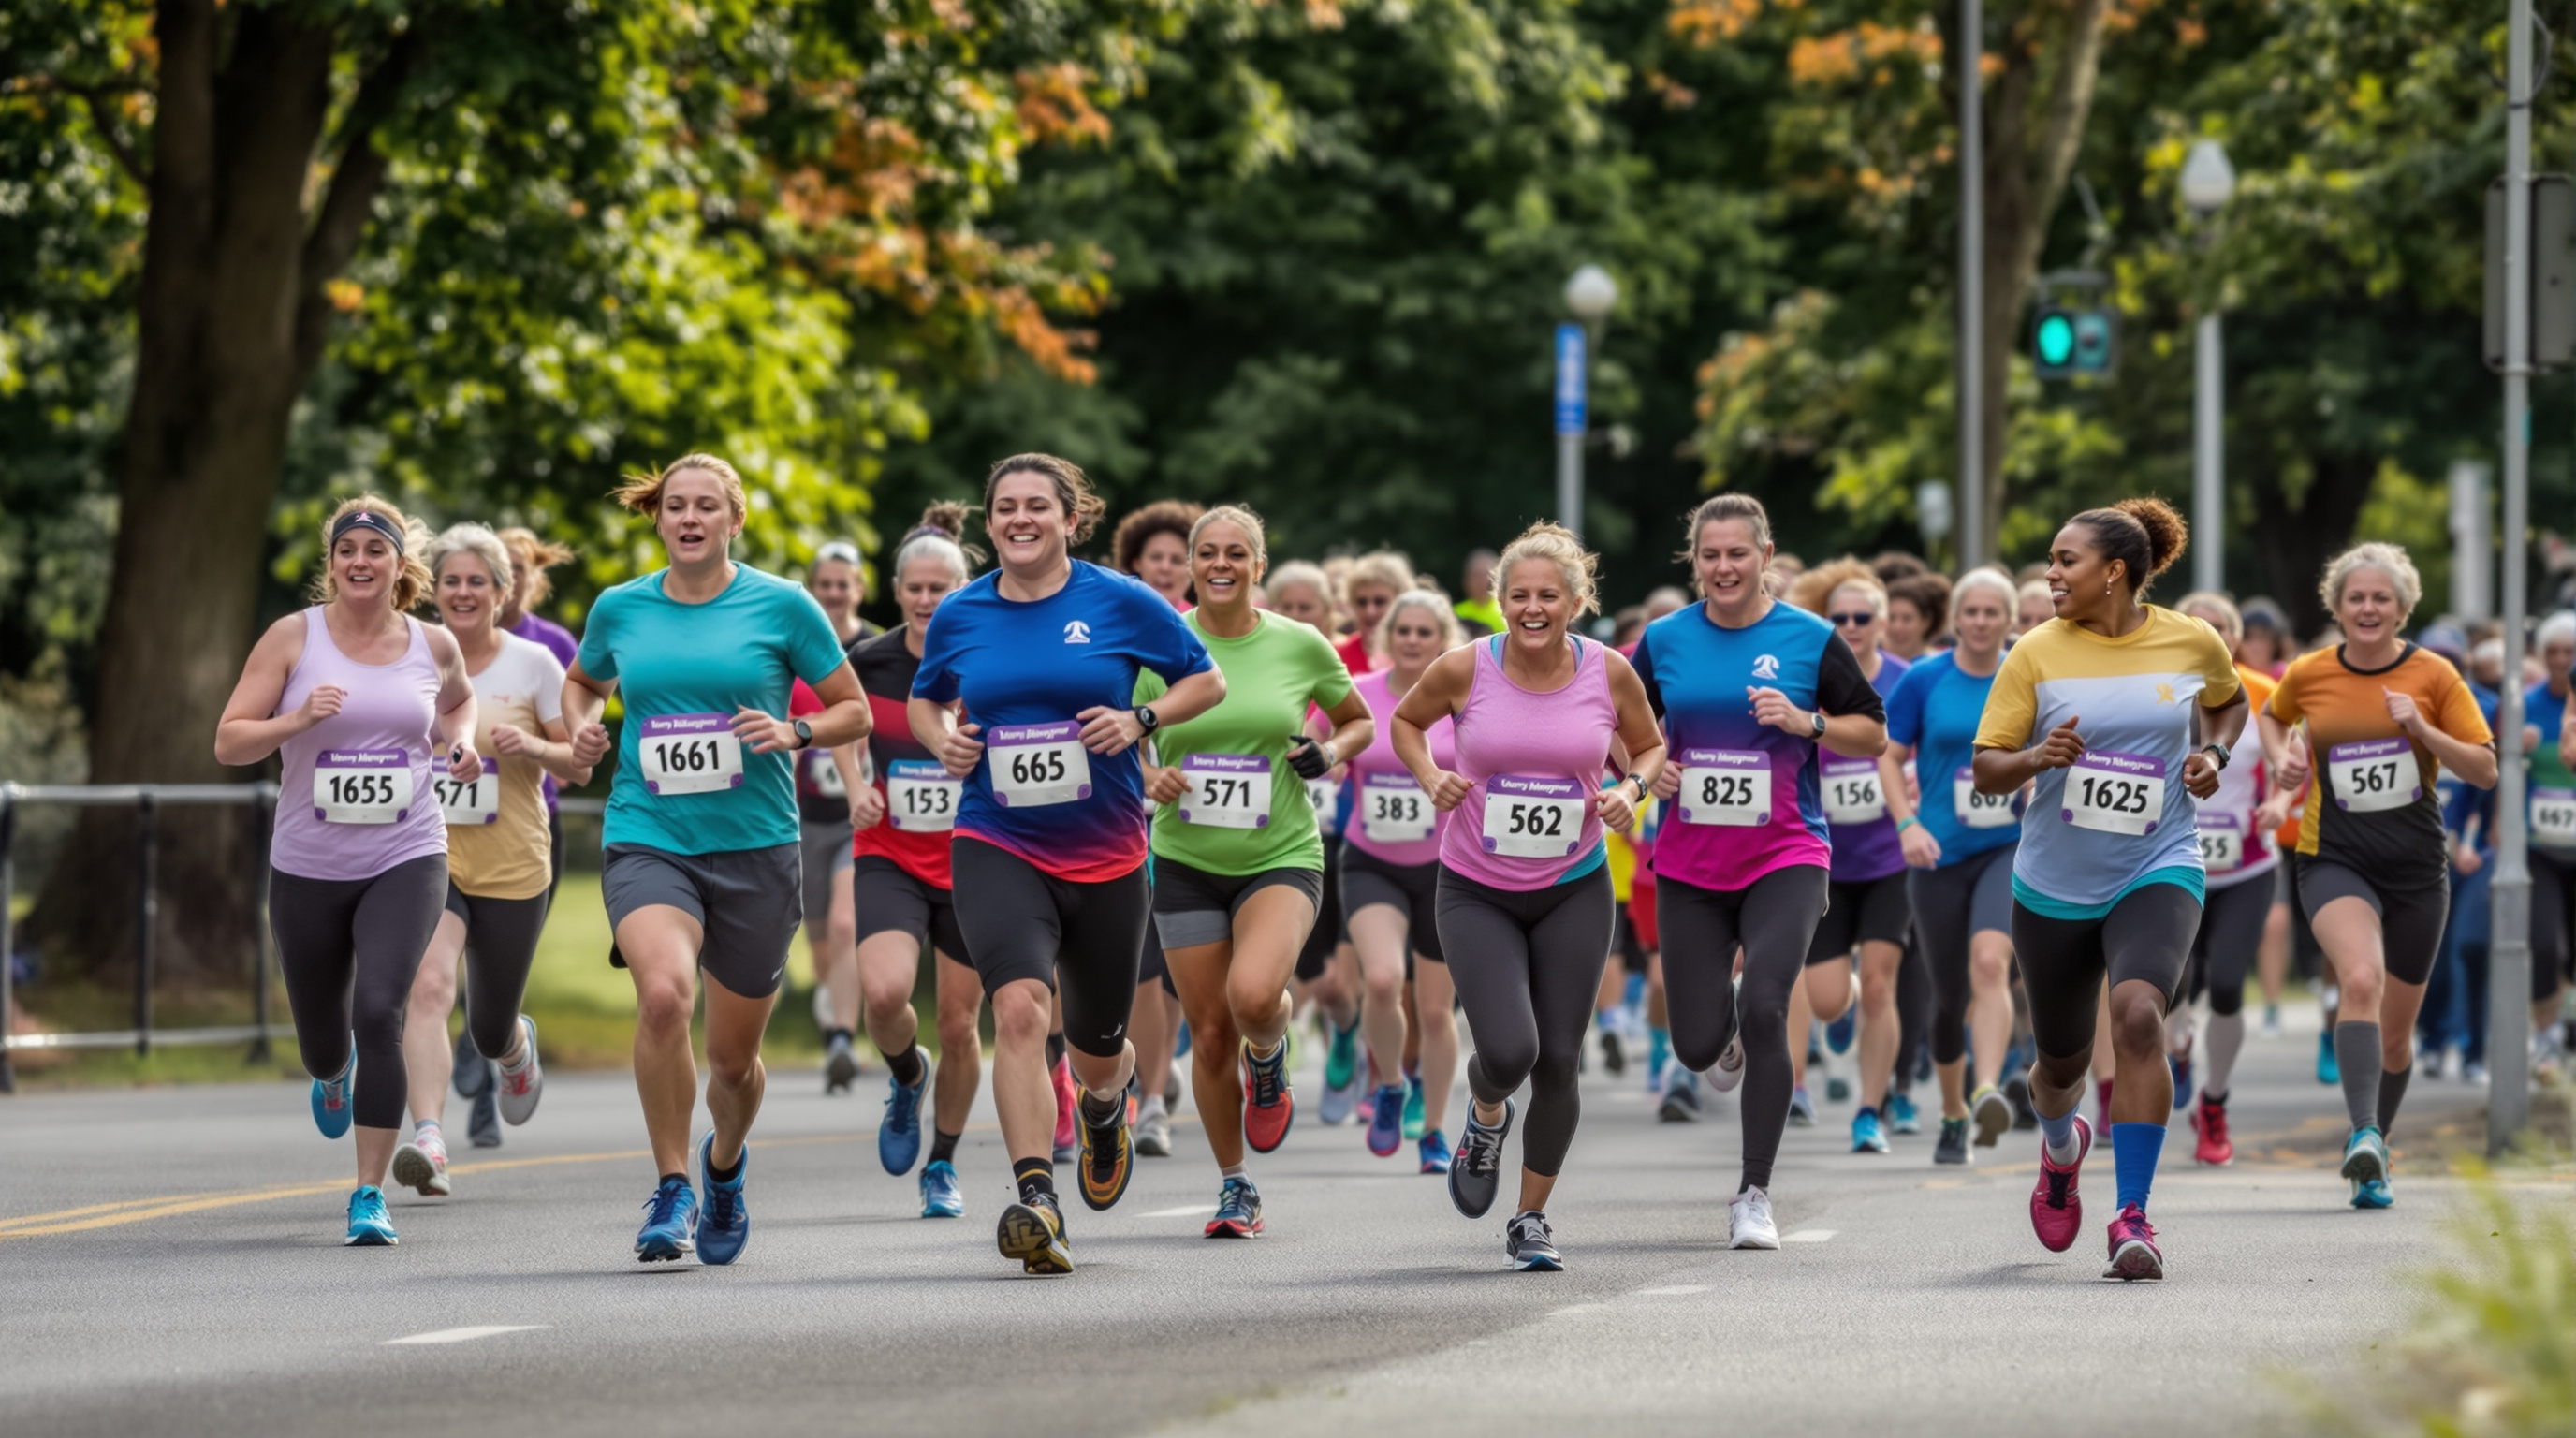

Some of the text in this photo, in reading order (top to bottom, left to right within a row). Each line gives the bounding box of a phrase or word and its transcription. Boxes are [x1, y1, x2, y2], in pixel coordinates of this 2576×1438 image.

[655, 740, 719, 773] 1661
[1012, 750, 1065, 784] 665
[329, 775, 394, 804] 1655
[1203, 778, 1250, 808] 571
[1702, 775, 1753, 806] 825
[1834, 781, 1876, 806] 156
[2351, 762, 2397, 795] 567
[905, 787, 950, 814] 153
[1375, 795, 1419, 821] 383
[2082, 777, 2149, 814] 1625
[1509, 803, 1562, 836] 562
